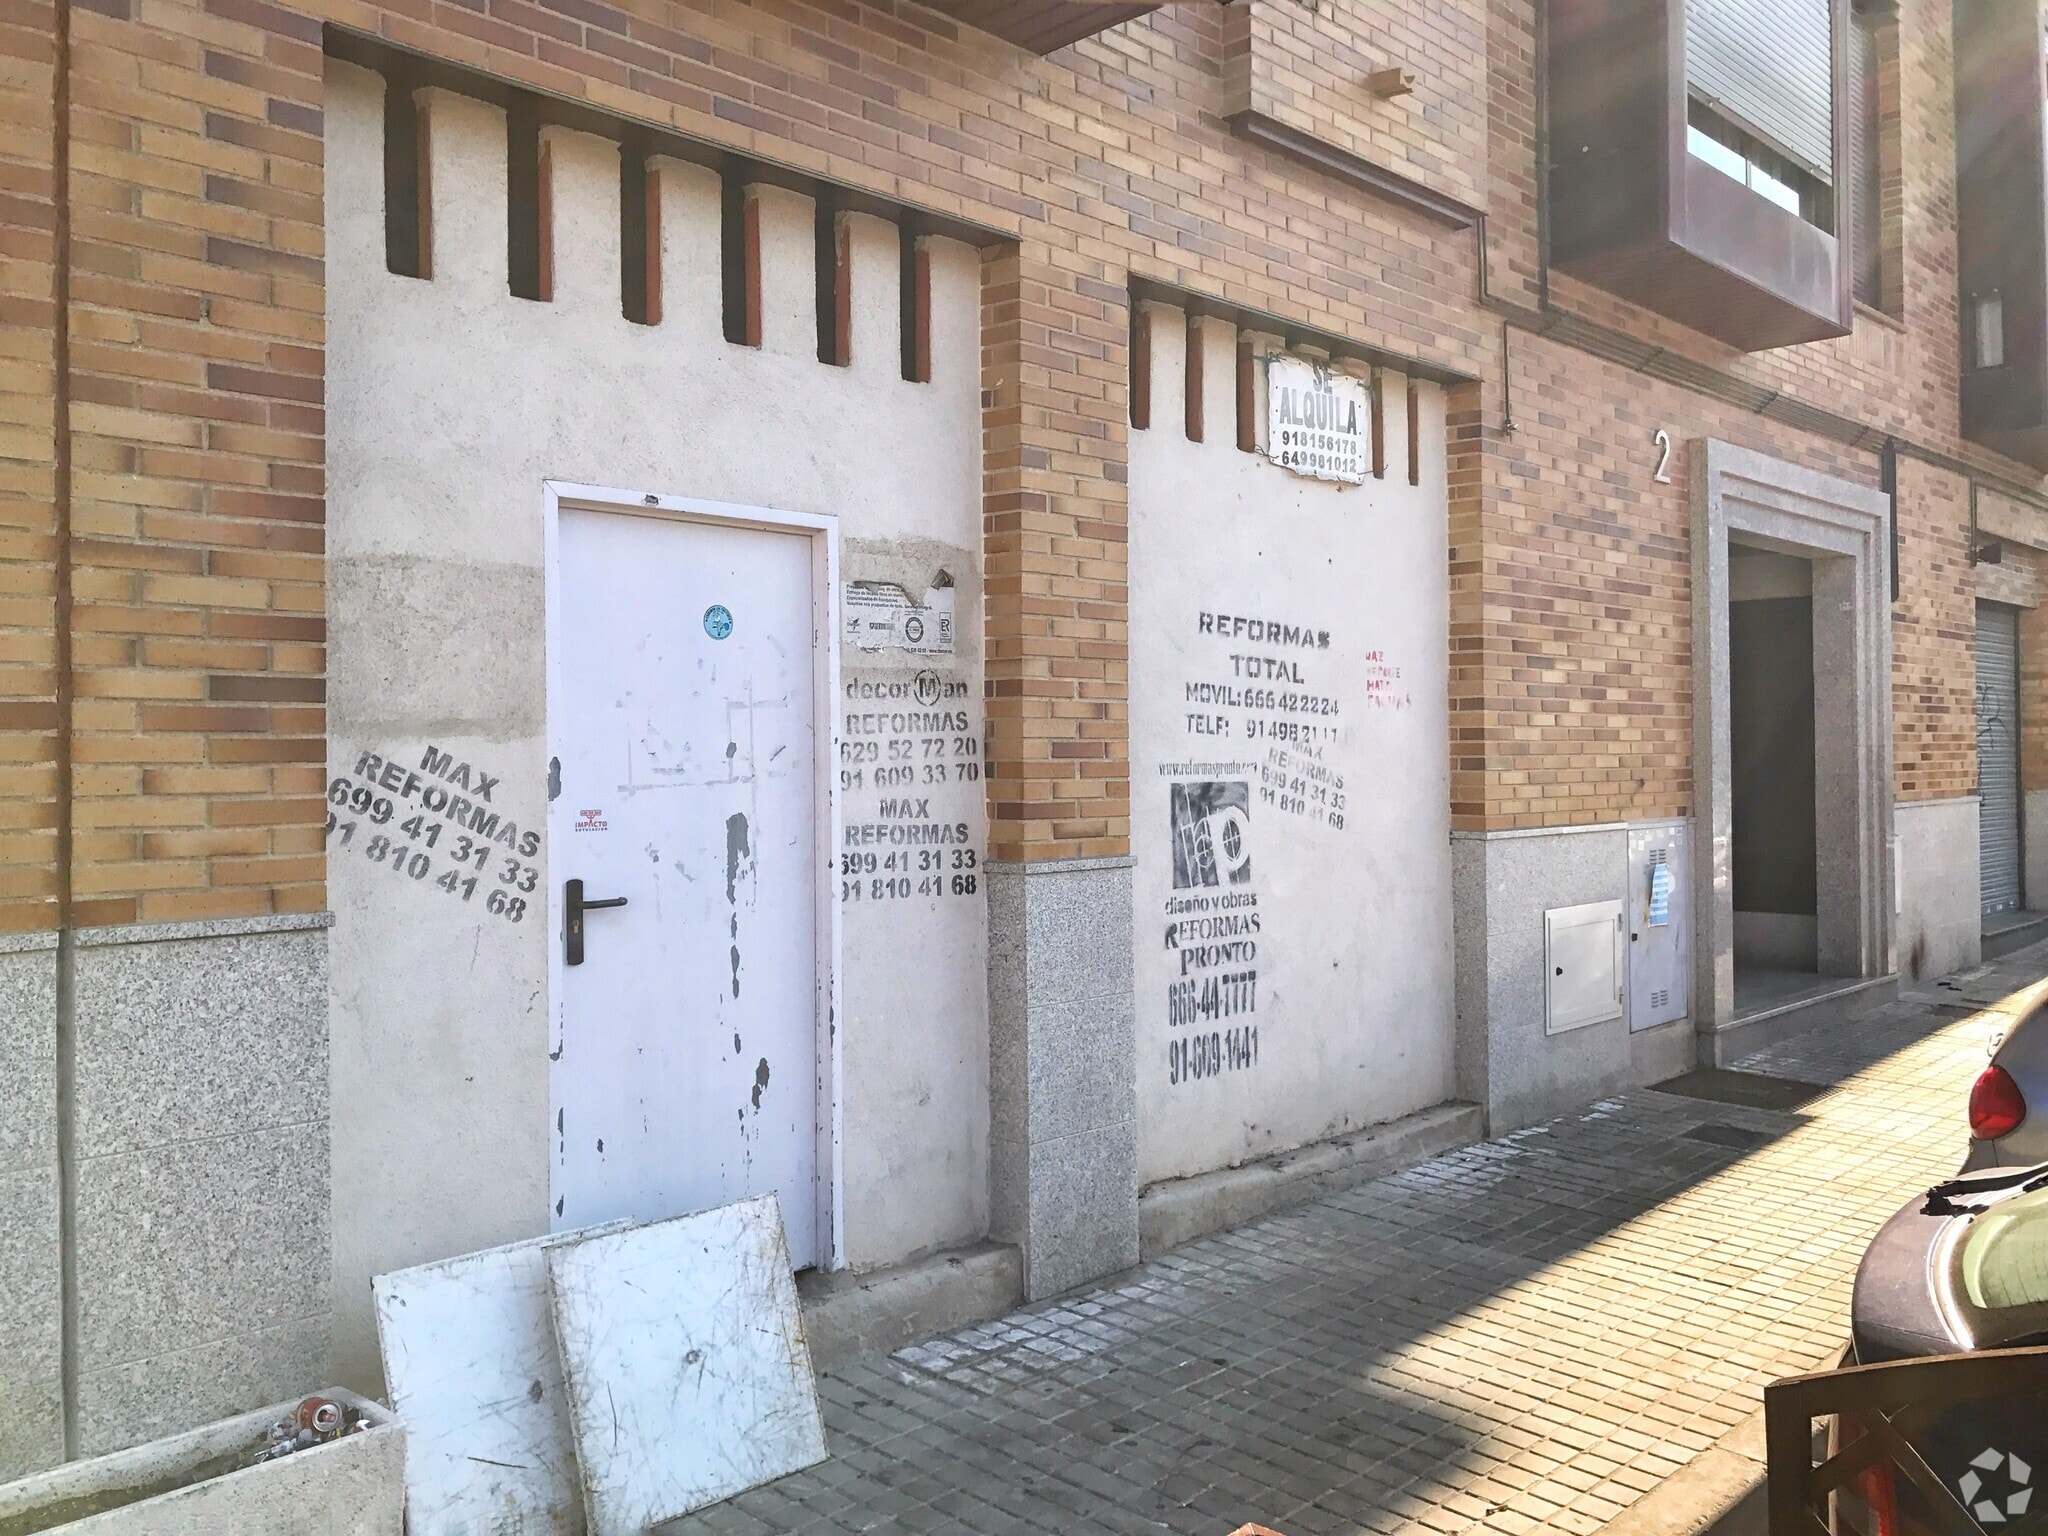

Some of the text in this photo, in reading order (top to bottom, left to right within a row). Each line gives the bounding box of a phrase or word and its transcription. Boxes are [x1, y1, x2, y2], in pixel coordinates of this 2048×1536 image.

[1280, 387, 1357, 435] ALQUILA
[1282, 431, 1356, 455] 918156178
[1653, 429, 1670, 483] 2
[1282, 451, 1356, 473] 649981012
[1199, 611, 1330, 649] REFORMAS
[1229, 654, 1305, 684] TOTAL
[846, 711, 968, 734] REFORMAS
[841, 737, 977, 763] 629 52 72 20
[420, 745, 499, 802] MAX
[841, 762, 978, 791] 91 609 33 70
[1269, 747, 1343, 789] REFORMAS
[1290, 777, 1306, 796] 41
[354, 750, 541, 857] REFORMAS
[880, 798, 930, 818] MAX
[1280, 794, 1305, 815] 810
[1328, 812, 1344, 830] 68
[328, 778, 538, 892] 699 41 31 33
[575, 820, 607, 828] IMPACTO
[845, 823, 969, 846] REFORMAS
[884, 851, 908, 872] 41
[918, 850, 942, 871] 31
[951, 849, 976, 869] 33
[366, 835, 430, 880] 810
[437, 870, 478, 901] 41
[487, 889, 526, 922] 68
[871, 878, 911, 899] 810
[918, 876, 942, 896] 41
[952, 875, 976, 895] 68
[1165, 891, 1257, 915] diseño y obras
[1165, 913, 1260, 949] REFORMAS
[1181, 940, 1256, 976] PRONTO
